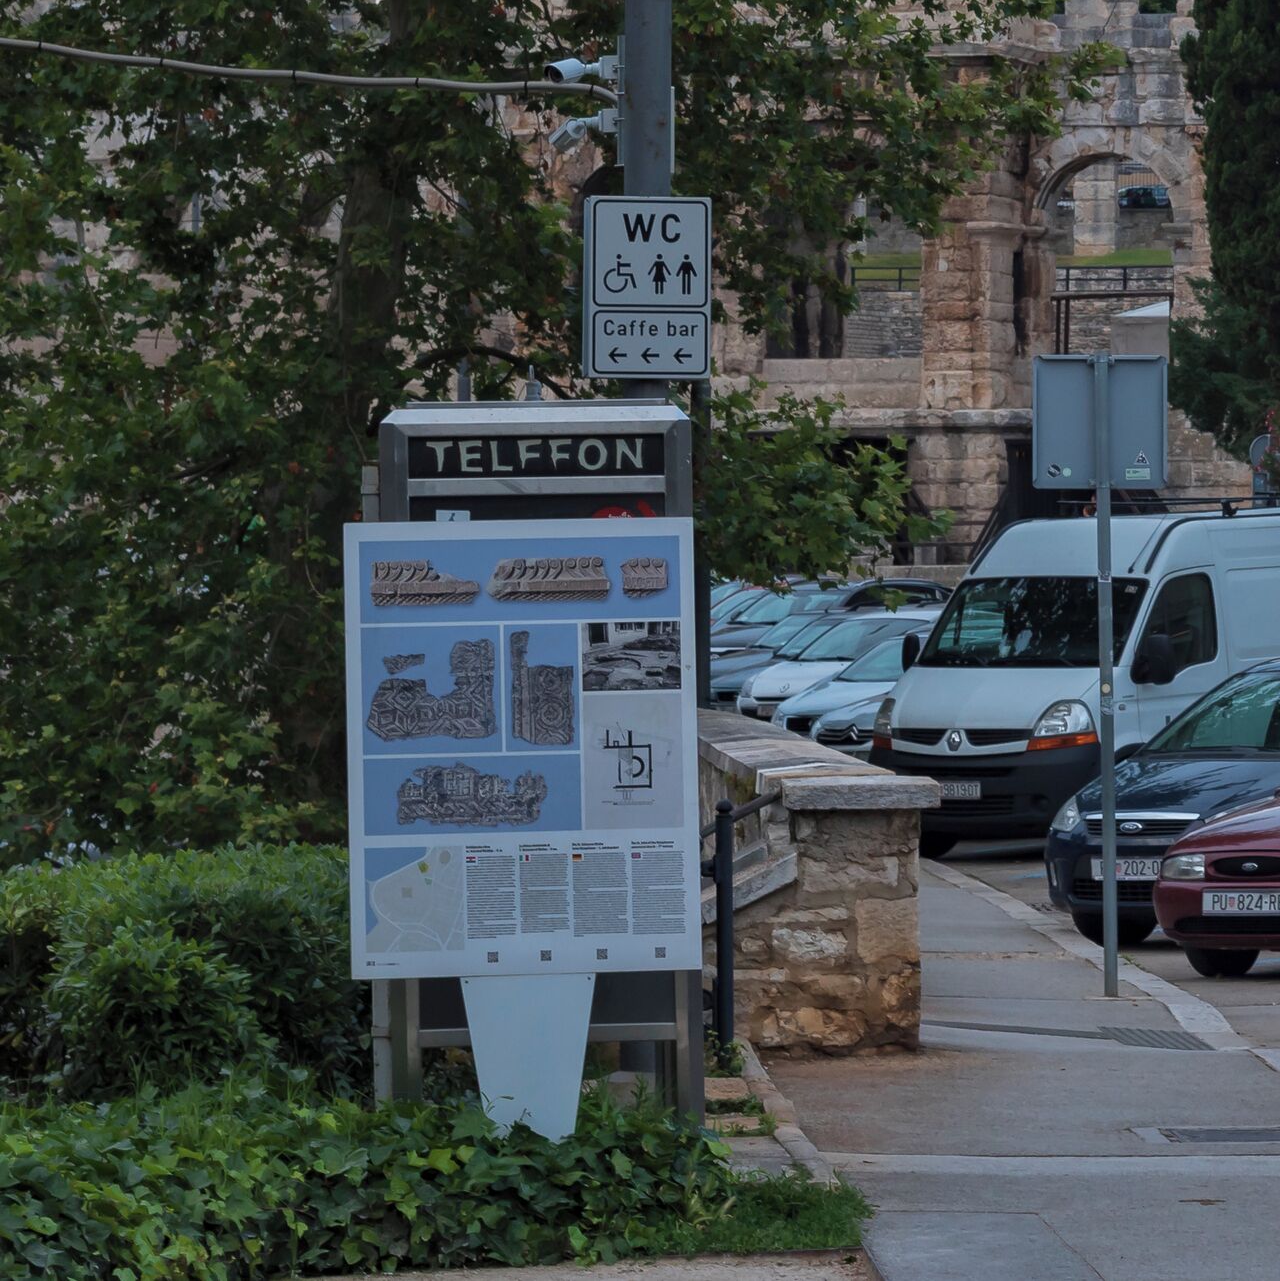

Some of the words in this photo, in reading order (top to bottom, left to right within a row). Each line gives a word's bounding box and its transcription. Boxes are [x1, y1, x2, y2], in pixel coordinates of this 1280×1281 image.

[623, 213, 681, 243] WC
[604, 320, 659, 337] Caffe
[667, 320, 699, 337] bar
[1212, 894, 1228, 911] PU
